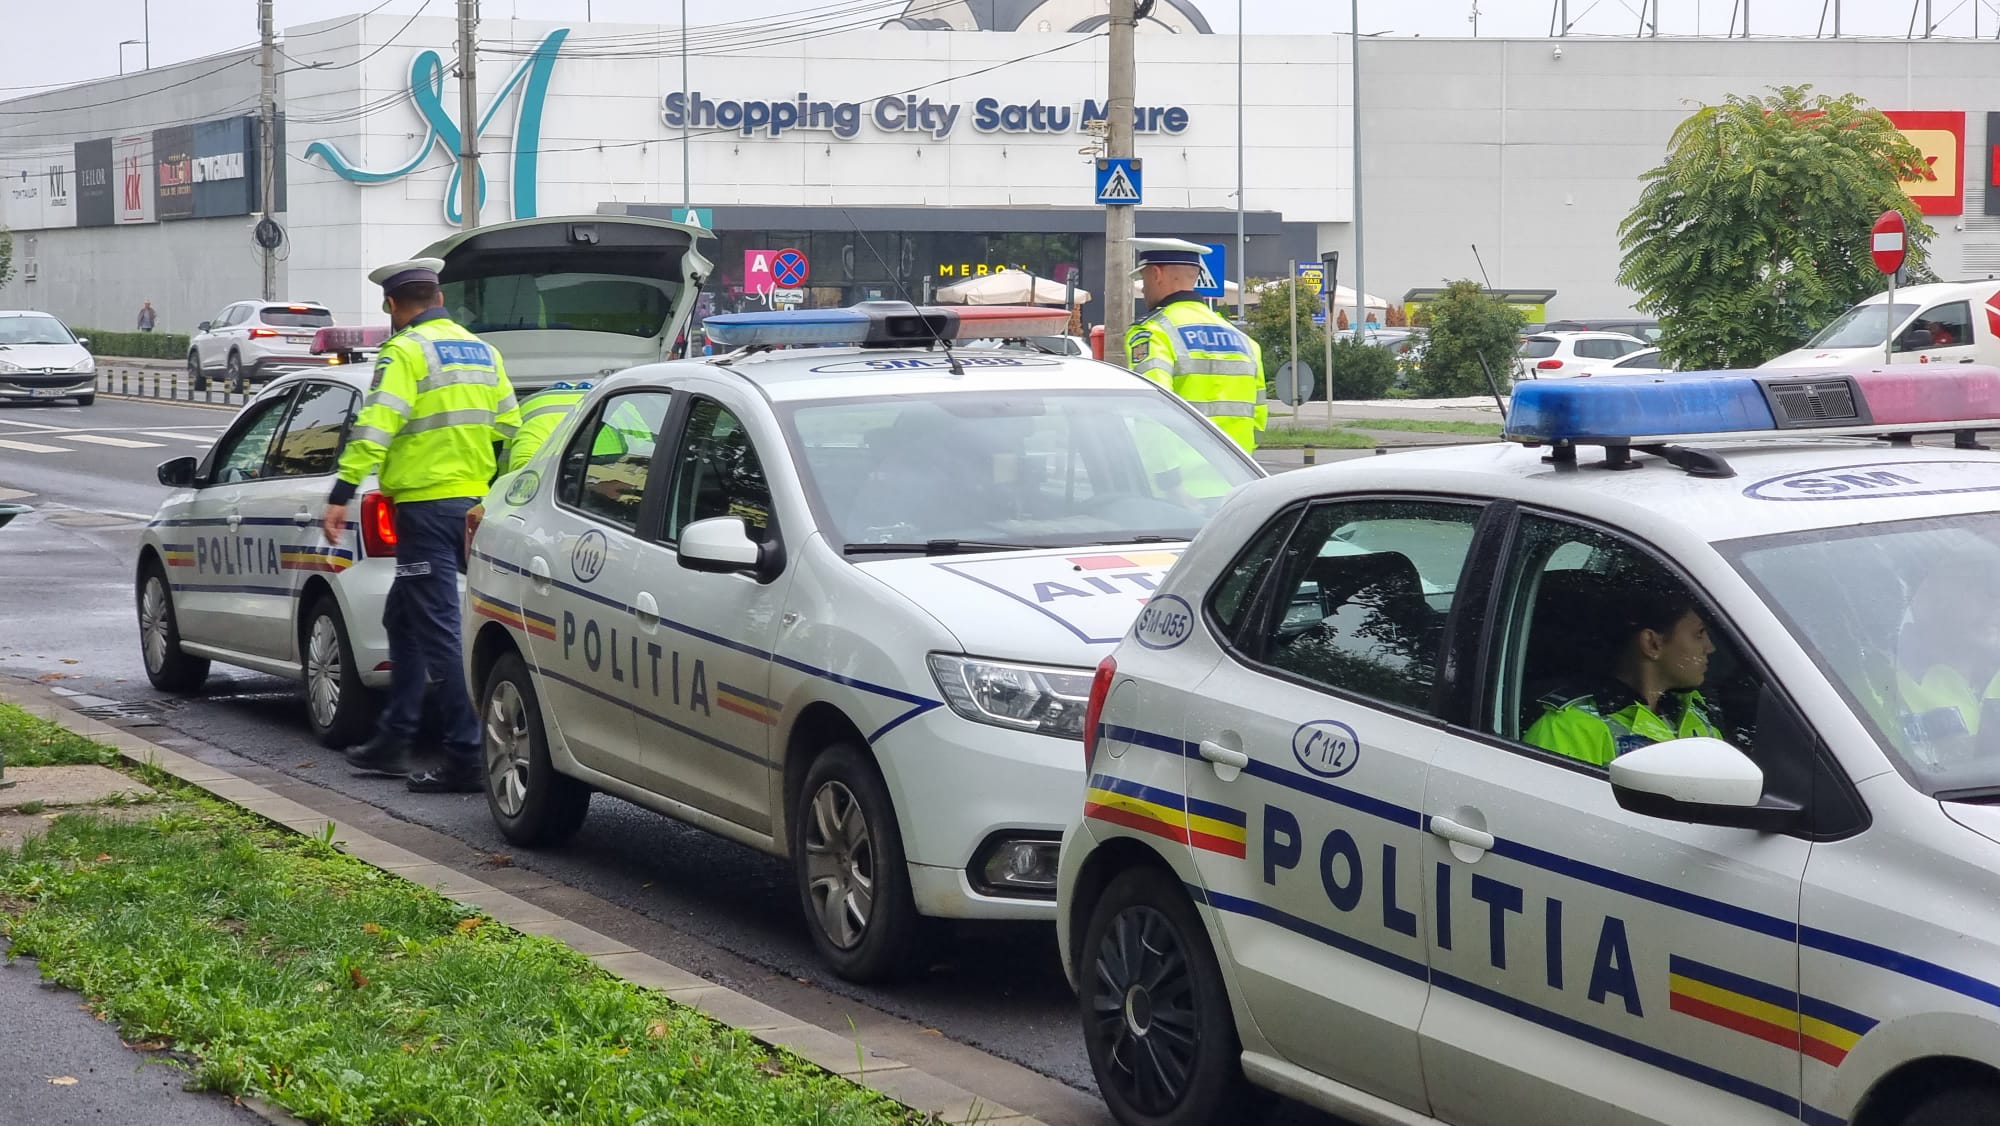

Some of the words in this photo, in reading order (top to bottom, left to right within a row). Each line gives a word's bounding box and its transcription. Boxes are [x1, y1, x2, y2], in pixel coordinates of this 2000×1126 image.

[664, 91, 861, 137] Shopping
[874, 94, 960, 139] City
[975, 97, 1071, 132] Satu
[685, 209, 701, 227] A
[751, 254, 769, 272] A
[197, 536, 280, 576] POLITIA
[580, 548, 600, 575] 112
[1033, 571, 1169, 603] AIT
[1139, 607, 1188, 639] SM-055
[563, 609, 711, 718] POLITIA
[1321, 737, 1346, 768] 112
[1263, 803, 1644, 1019] POLITIA
